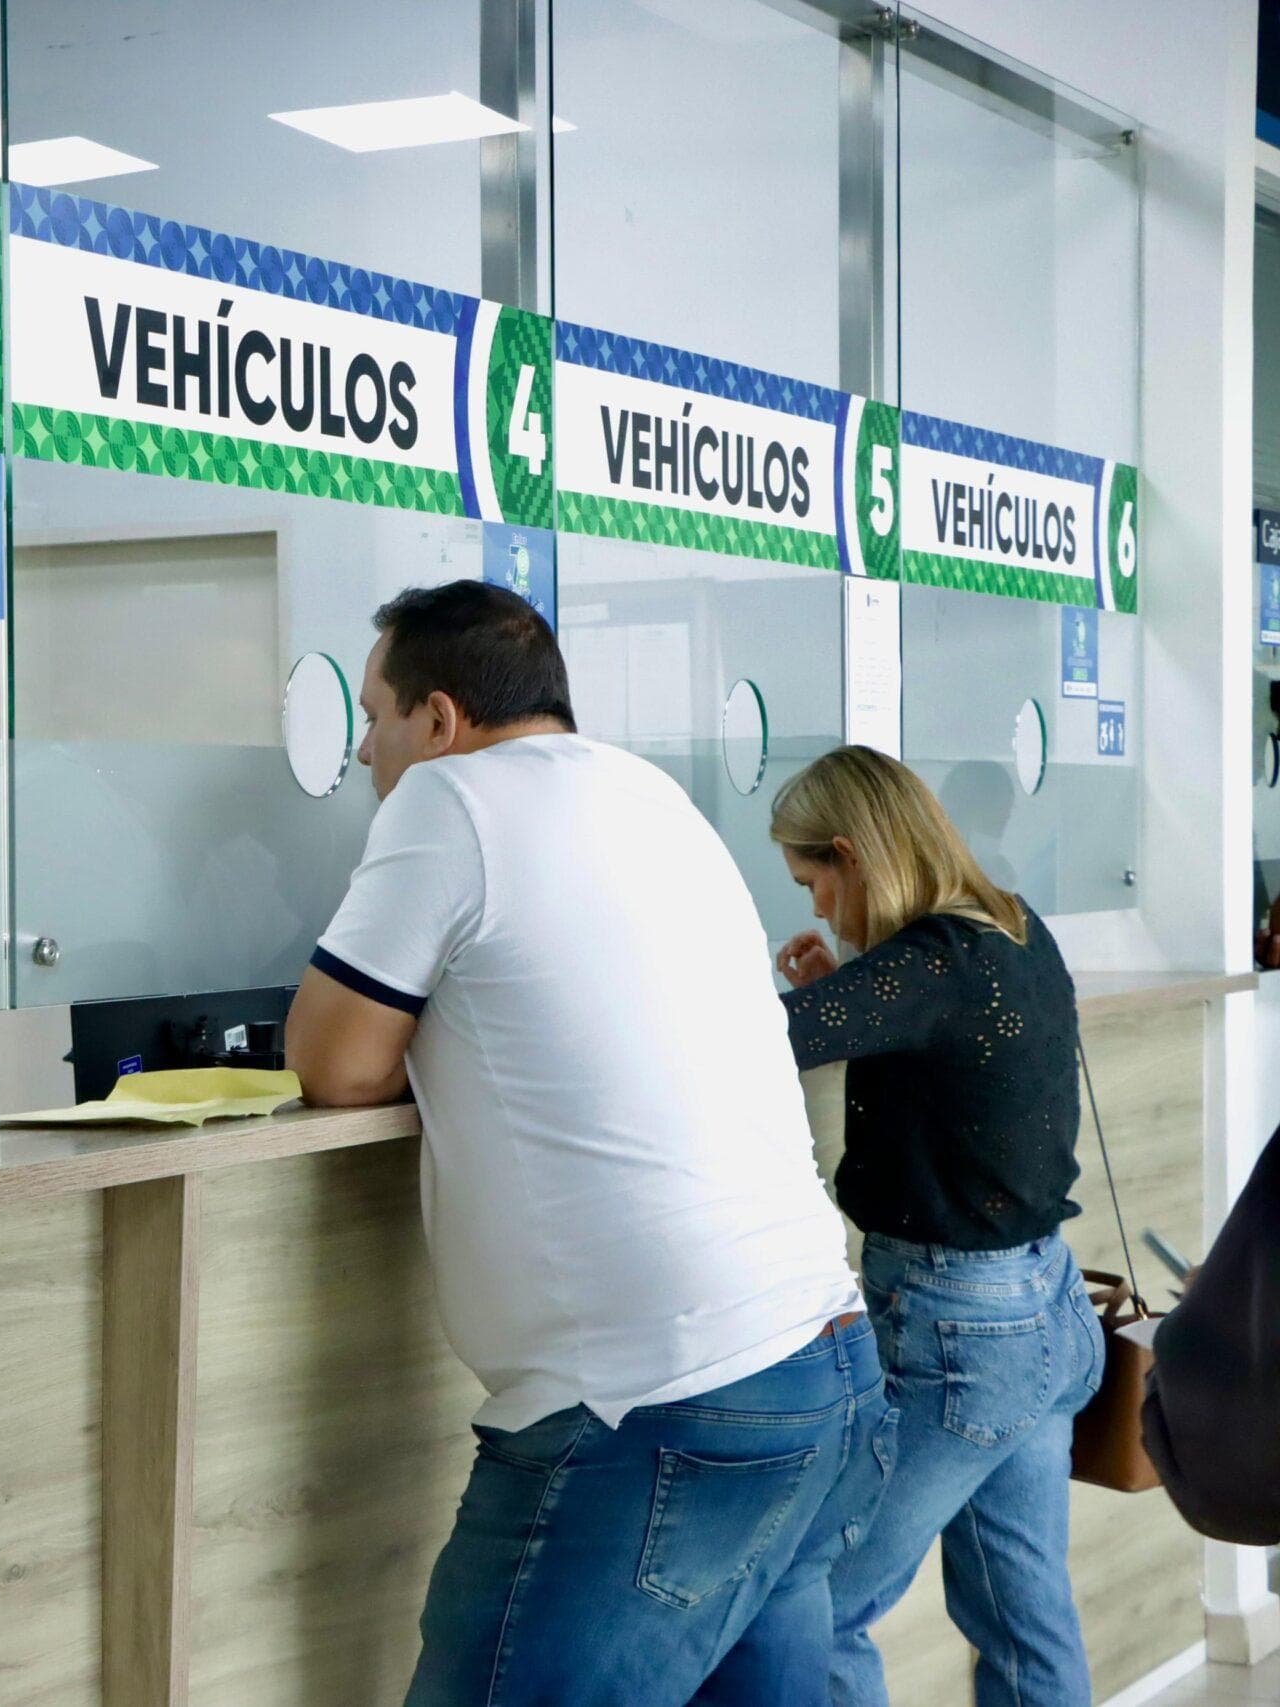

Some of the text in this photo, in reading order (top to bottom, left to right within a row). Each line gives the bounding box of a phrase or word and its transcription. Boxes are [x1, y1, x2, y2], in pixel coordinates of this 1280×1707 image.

[84, 296, 547, 476] VEHÍCULOS 4
[600, 402, 894, 536] VEHÍCULOS 5
[931, 474, 1137, 579] VEHÍCULOS 6
